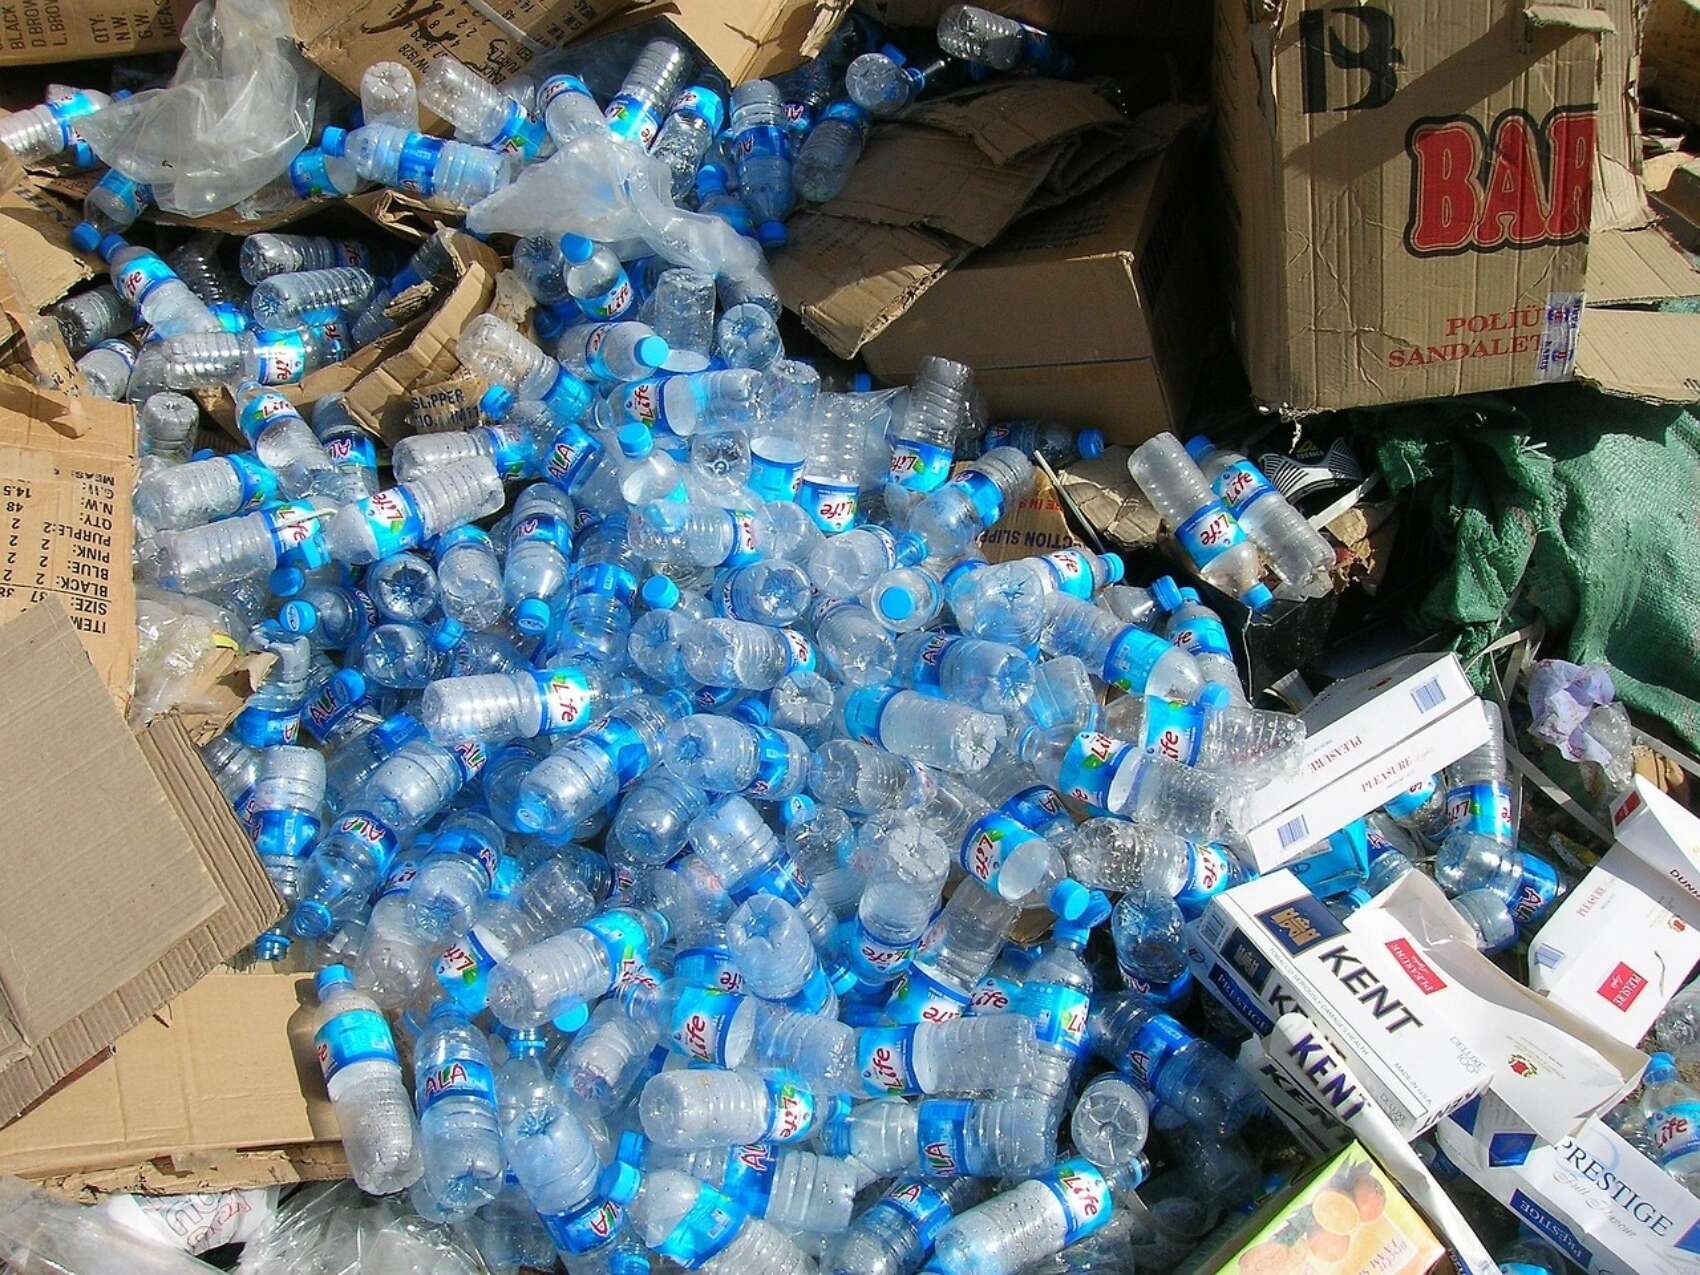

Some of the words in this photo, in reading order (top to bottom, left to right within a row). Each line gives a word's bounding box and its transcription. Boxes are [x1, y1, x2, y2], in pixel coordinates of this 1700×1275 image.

[1225, 470, 1254, 504] Life
[6, 501, 24, 513] 48
[819, 500, 856, 520] Life
[11, 517, 21, 530] 2
[1198, 514, 1230, 548] Life
[9, 534, 19, 547] 2
[41, 538, 51, 551] 2
[1023, 530, 1079, 549] CTION
[7, 552, 17, 565] 2
[39, 555, 49, 568] 2
[72, 543, 110, 564] PINK:
[3, 569, 13, 582] 2
[35, 572, 46, 585] 2
[67, 559, 109, 581] BLUE:
[56, 575, 109, 598] BLACK:
[70, 596, 108, 616] SIZE:
[1318, 945, 1424, 1035] KENT
[686, 1014, 711, 1061] Life
[872, 1047, 902, 1090] Life
[1287, 1032, 1371, 1122] KENT
[424, 1062, 467, 1097] ALA
[780, 1096, 798, 1139] Life
[1062, 1175, 1099, 1217] Life
